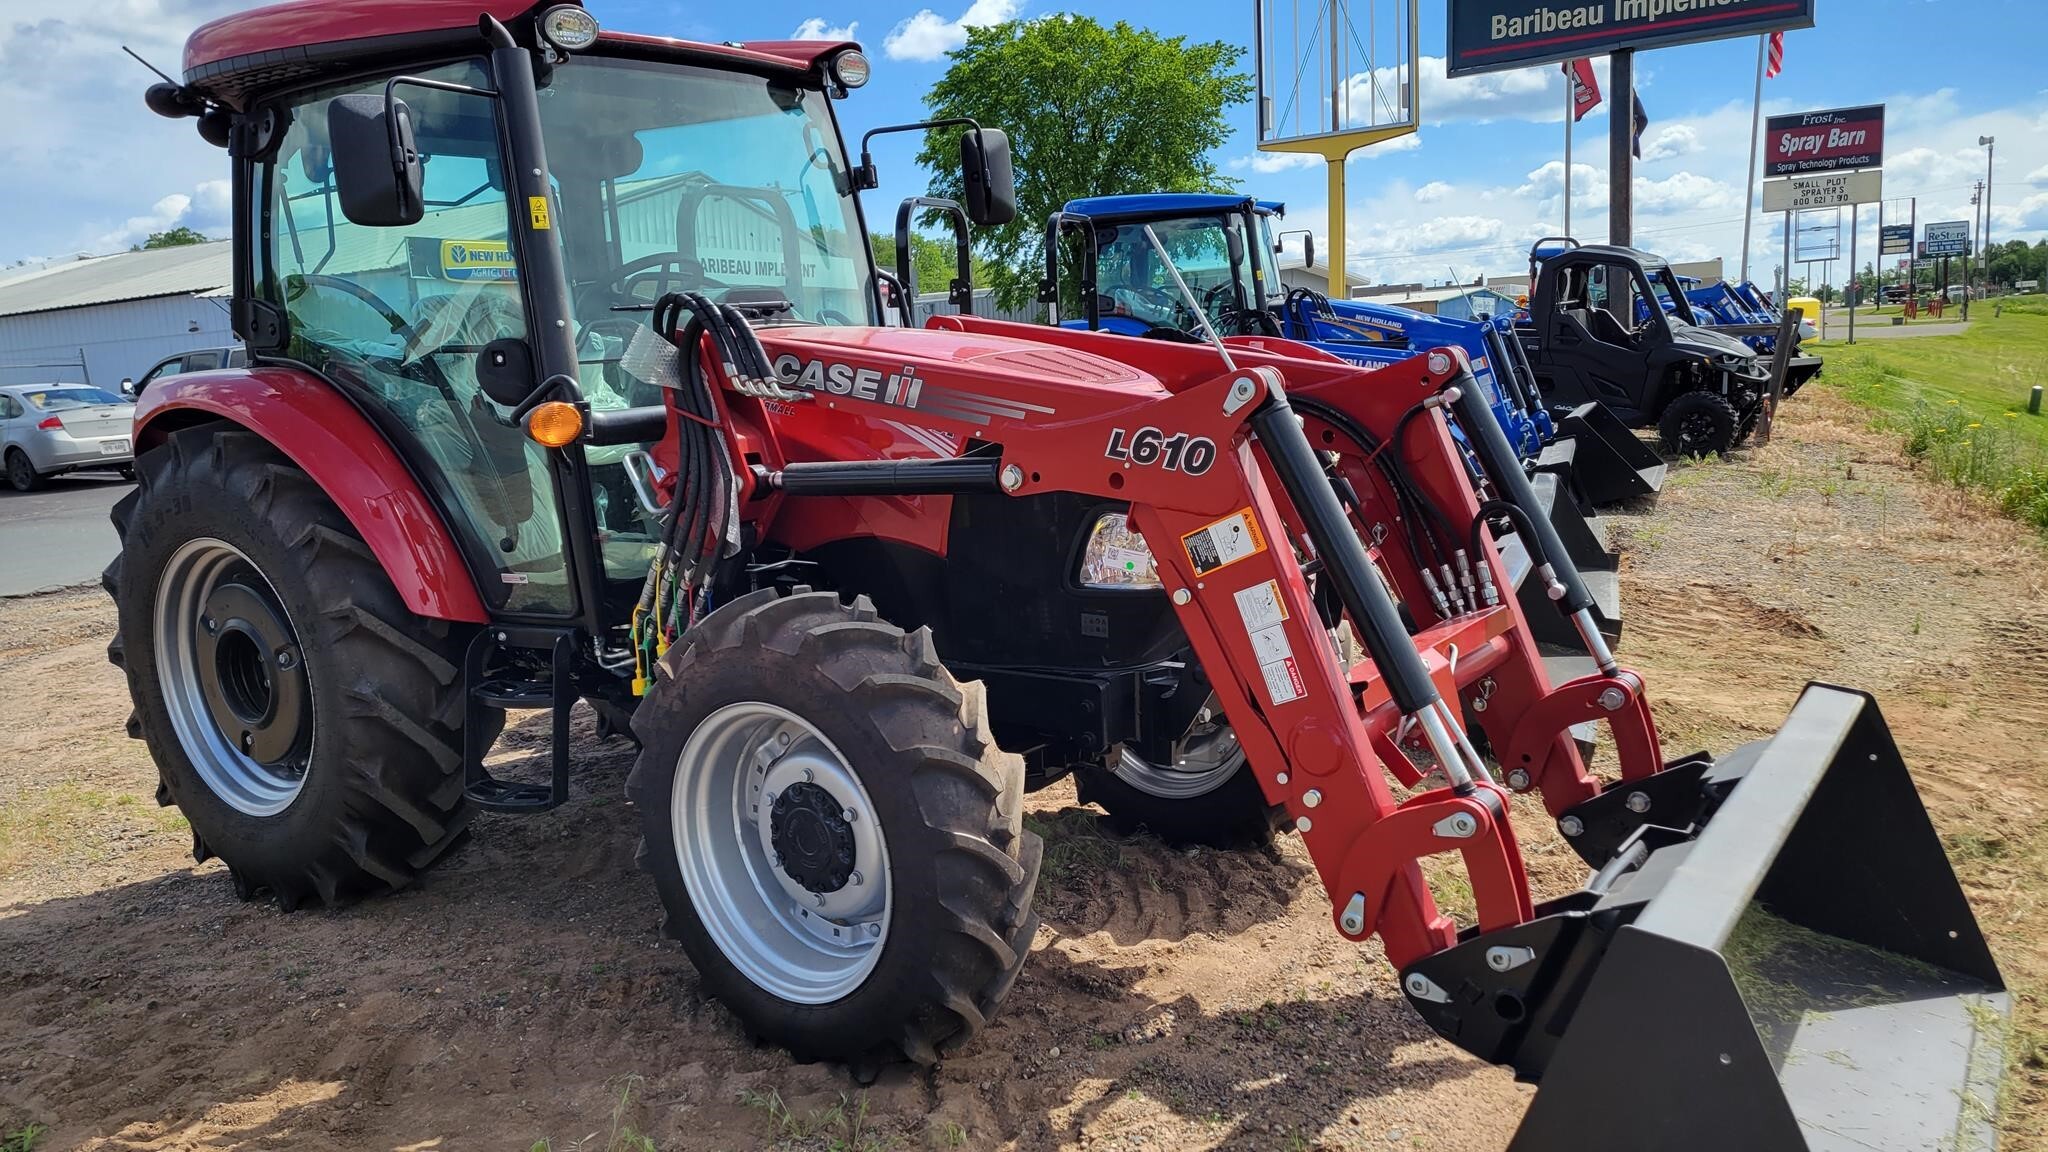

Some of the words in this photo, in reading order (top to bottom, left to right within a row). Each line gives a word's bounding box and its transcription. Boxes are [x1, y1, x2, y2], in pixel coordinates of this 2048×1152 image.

[1491, 4, 1604, 40] Baribeau
[1802, 113, 1833, 125] Frost
[1780, 133, 1825, 156] Spray
[1828, 128, 1866, 148] Barn
[1777, 163, 1796, 172] Spray
[1799, 158, 1837, 170] Technology
[1839, 155, 1870, 165] Products
[1793, 181, 1820, 190] SMALL
[1826, 177, 1847, 187] PLOT
[1793, 197, 1810, 206] 800
[1814, 196, 1826, 204] 621
[469, 250, 493, 262] NEW
[702, 257, 751, 275] ARIBEAU
[1355, 314, 1372, 323] NEW
[1372, 317, 1403, 329] HOLLAND
[1345, 357, 1391, 370] OLLAND
[774, 354, 882, 401] CASE
[1104, 426, 1217, 476] L610
[1289, 667, 1303, 695] DANGER
